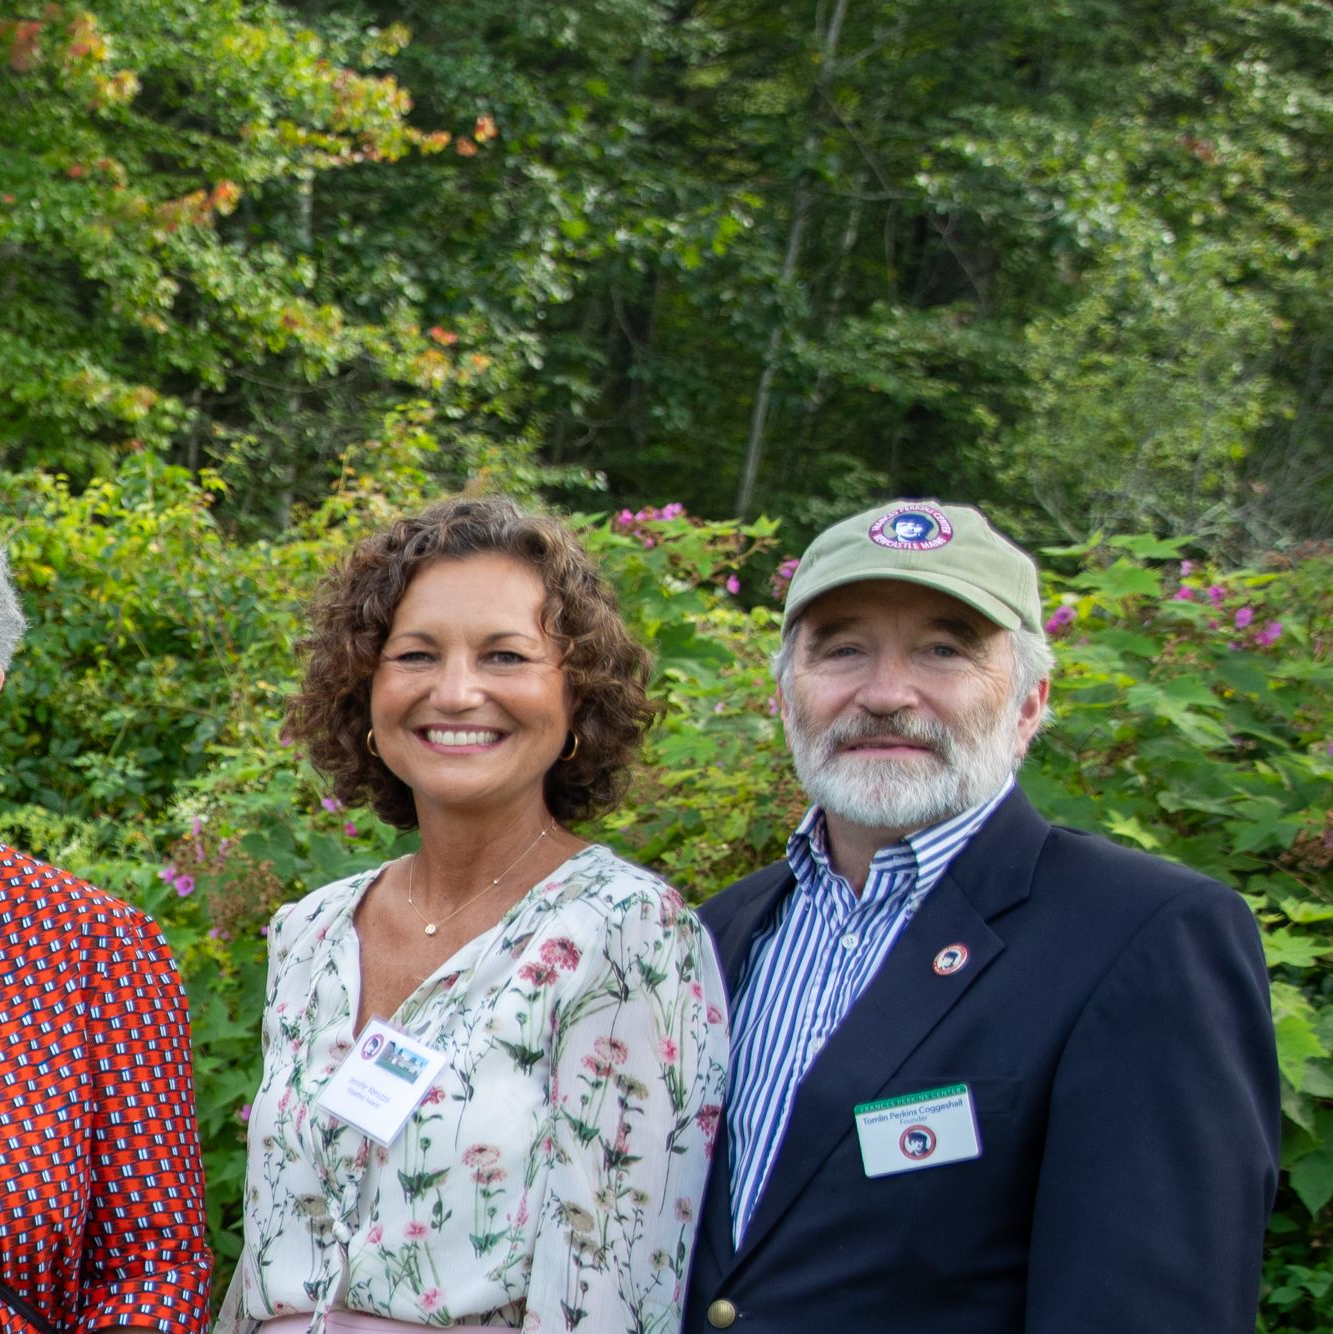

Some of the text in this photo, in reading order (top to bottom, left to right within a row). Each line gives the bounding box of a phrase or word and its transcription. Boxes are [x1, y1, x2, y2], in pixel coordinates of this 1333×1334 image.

[899, 505, 935, 514] PERKINS
[933, 512, 952, 534] CENTER
[920, 536, 947, 550] MAINE
[347, 1076, 391, 1104] Jennifer Abruzzo
[860, 1087, 961, 1113] FRANCES PERKINS CENTER
[863, 1099, 963, 1125] Tomlin Perkins Coggeshall
[899, 1115, 928, 1126] Founder
